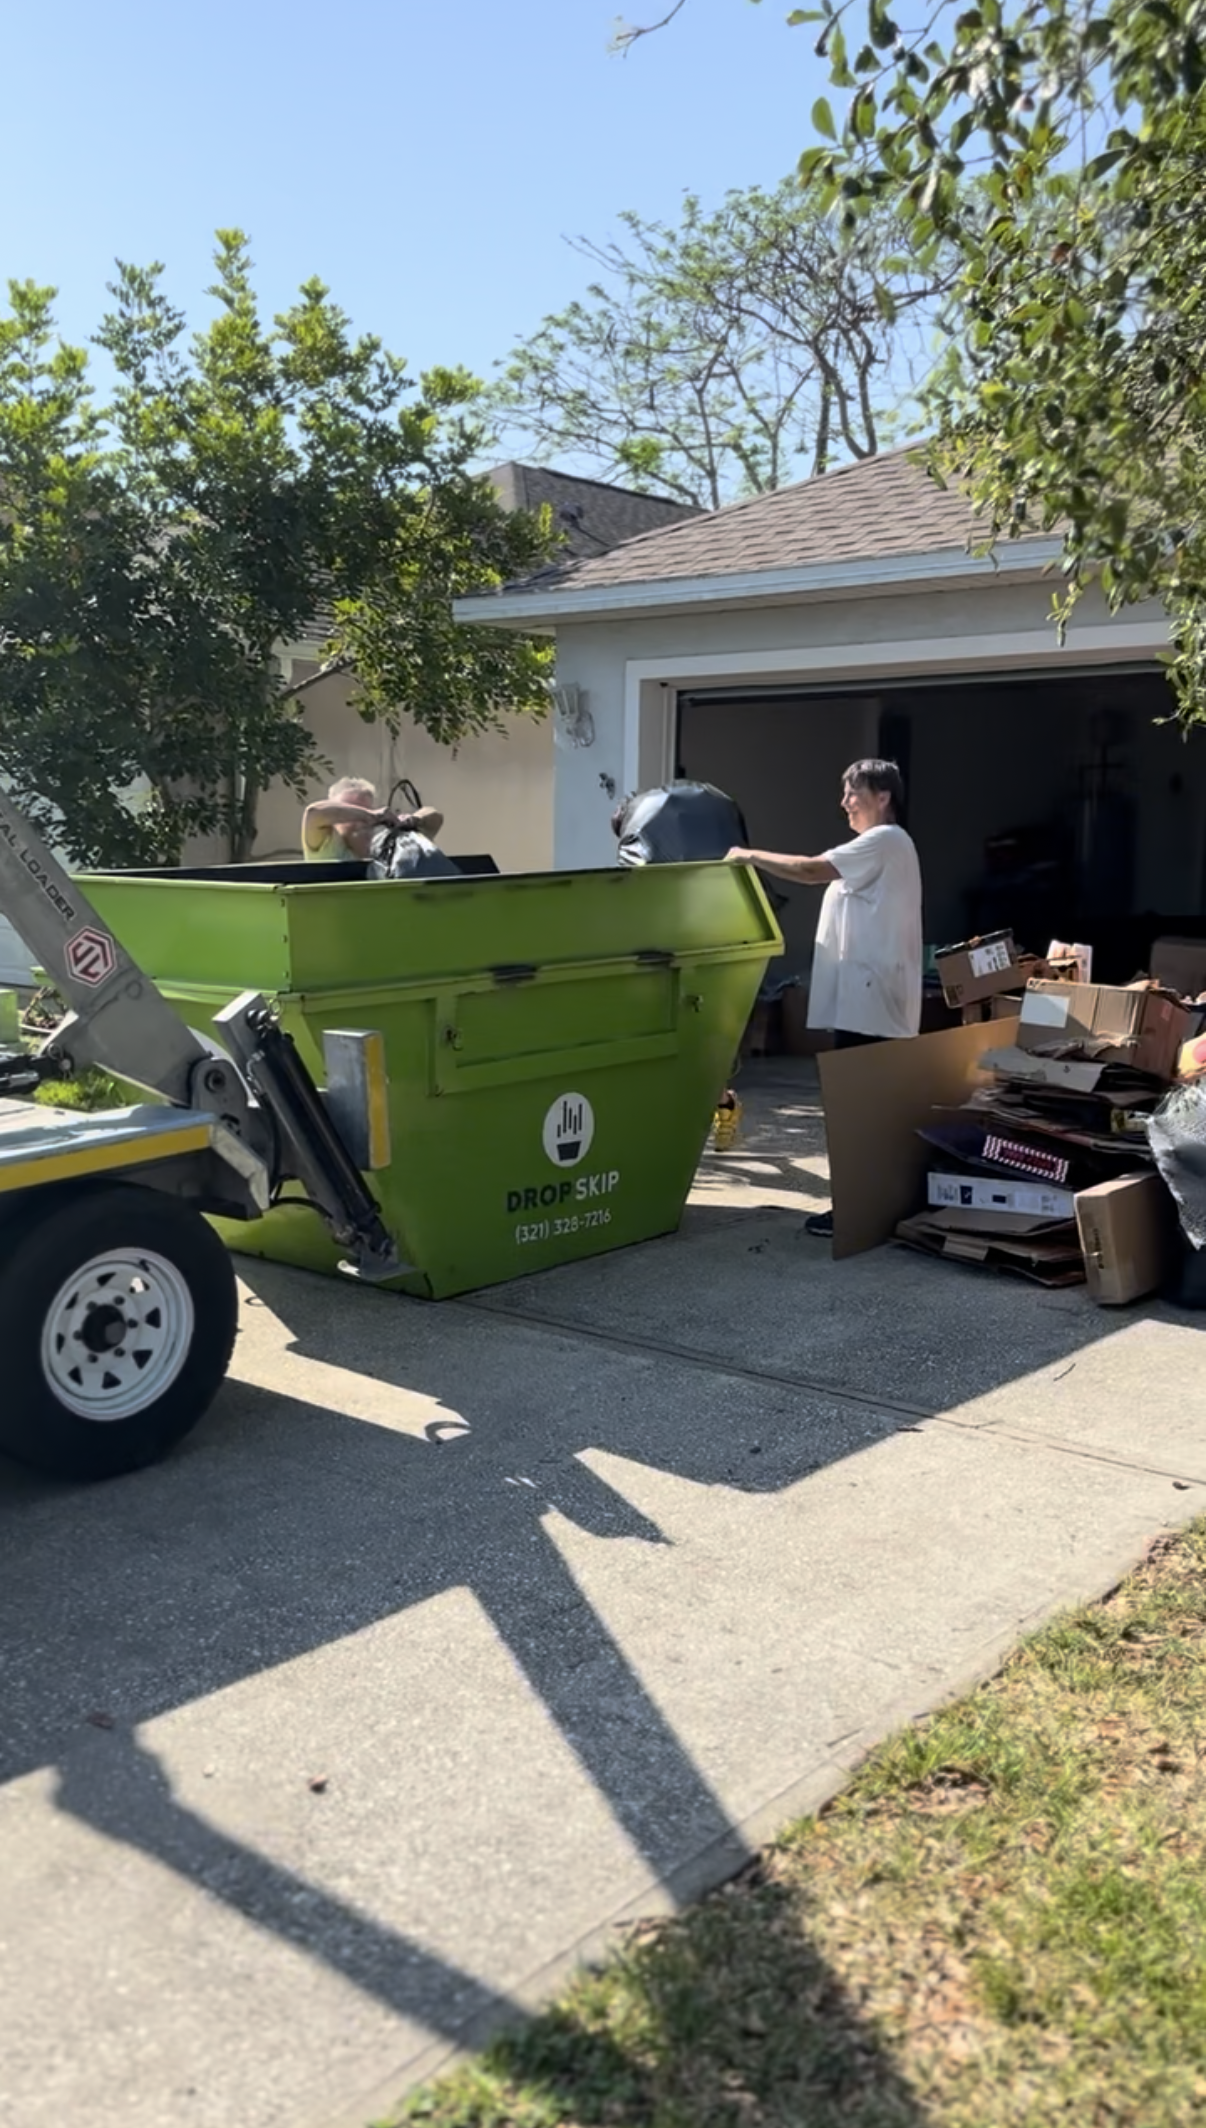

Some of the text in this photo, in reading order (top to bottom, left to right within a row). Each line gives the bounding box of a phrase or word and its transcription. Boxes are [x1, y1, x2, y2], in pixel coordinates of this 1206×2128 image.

[0, 814, 75, 920] AL LOADER
[507, 1171, 619, 1212] DROP SKIP
[515, 1208, 611, 1244] (321) 328-7216
